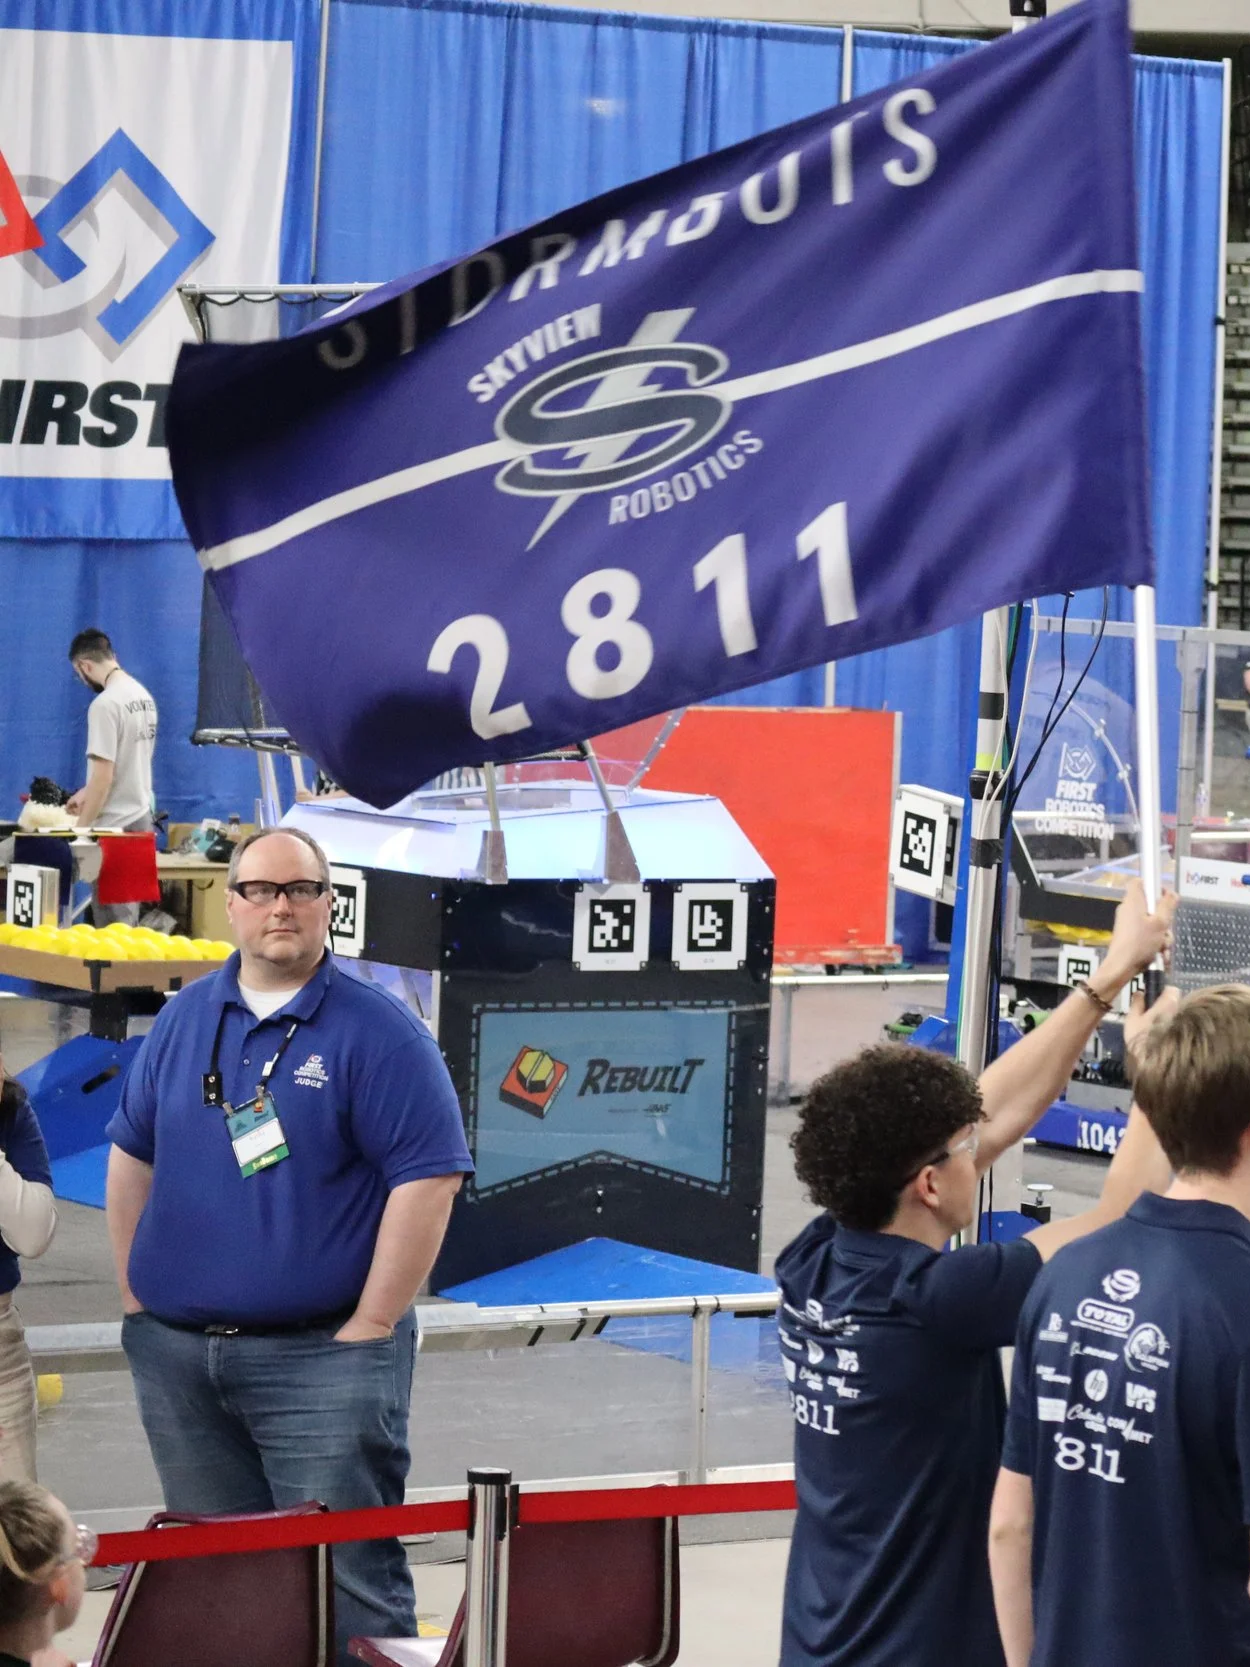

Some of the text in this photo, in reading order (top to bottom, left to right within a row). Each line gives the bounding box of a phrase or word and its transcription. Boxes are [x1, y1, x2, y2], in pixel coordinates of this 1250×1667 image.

[467, 302, 602, 403] SKYVIEW
[0, 379, 171, 448] IRST
[608, 430, 764, 525] ROBOTICS
[427, 501, 858, 740] 2811
[1045, 798, 1106, 821] ROBOTICS
[1056, 779, 1097, 802] FIRST
[1035, 816, 1115, 841] COMPETITION
[294, 1077, 324, 1089] JUDGE
[577, 1058, 706, 1098] REBUILT
[1053, 1432, 1126, 1484] 811
